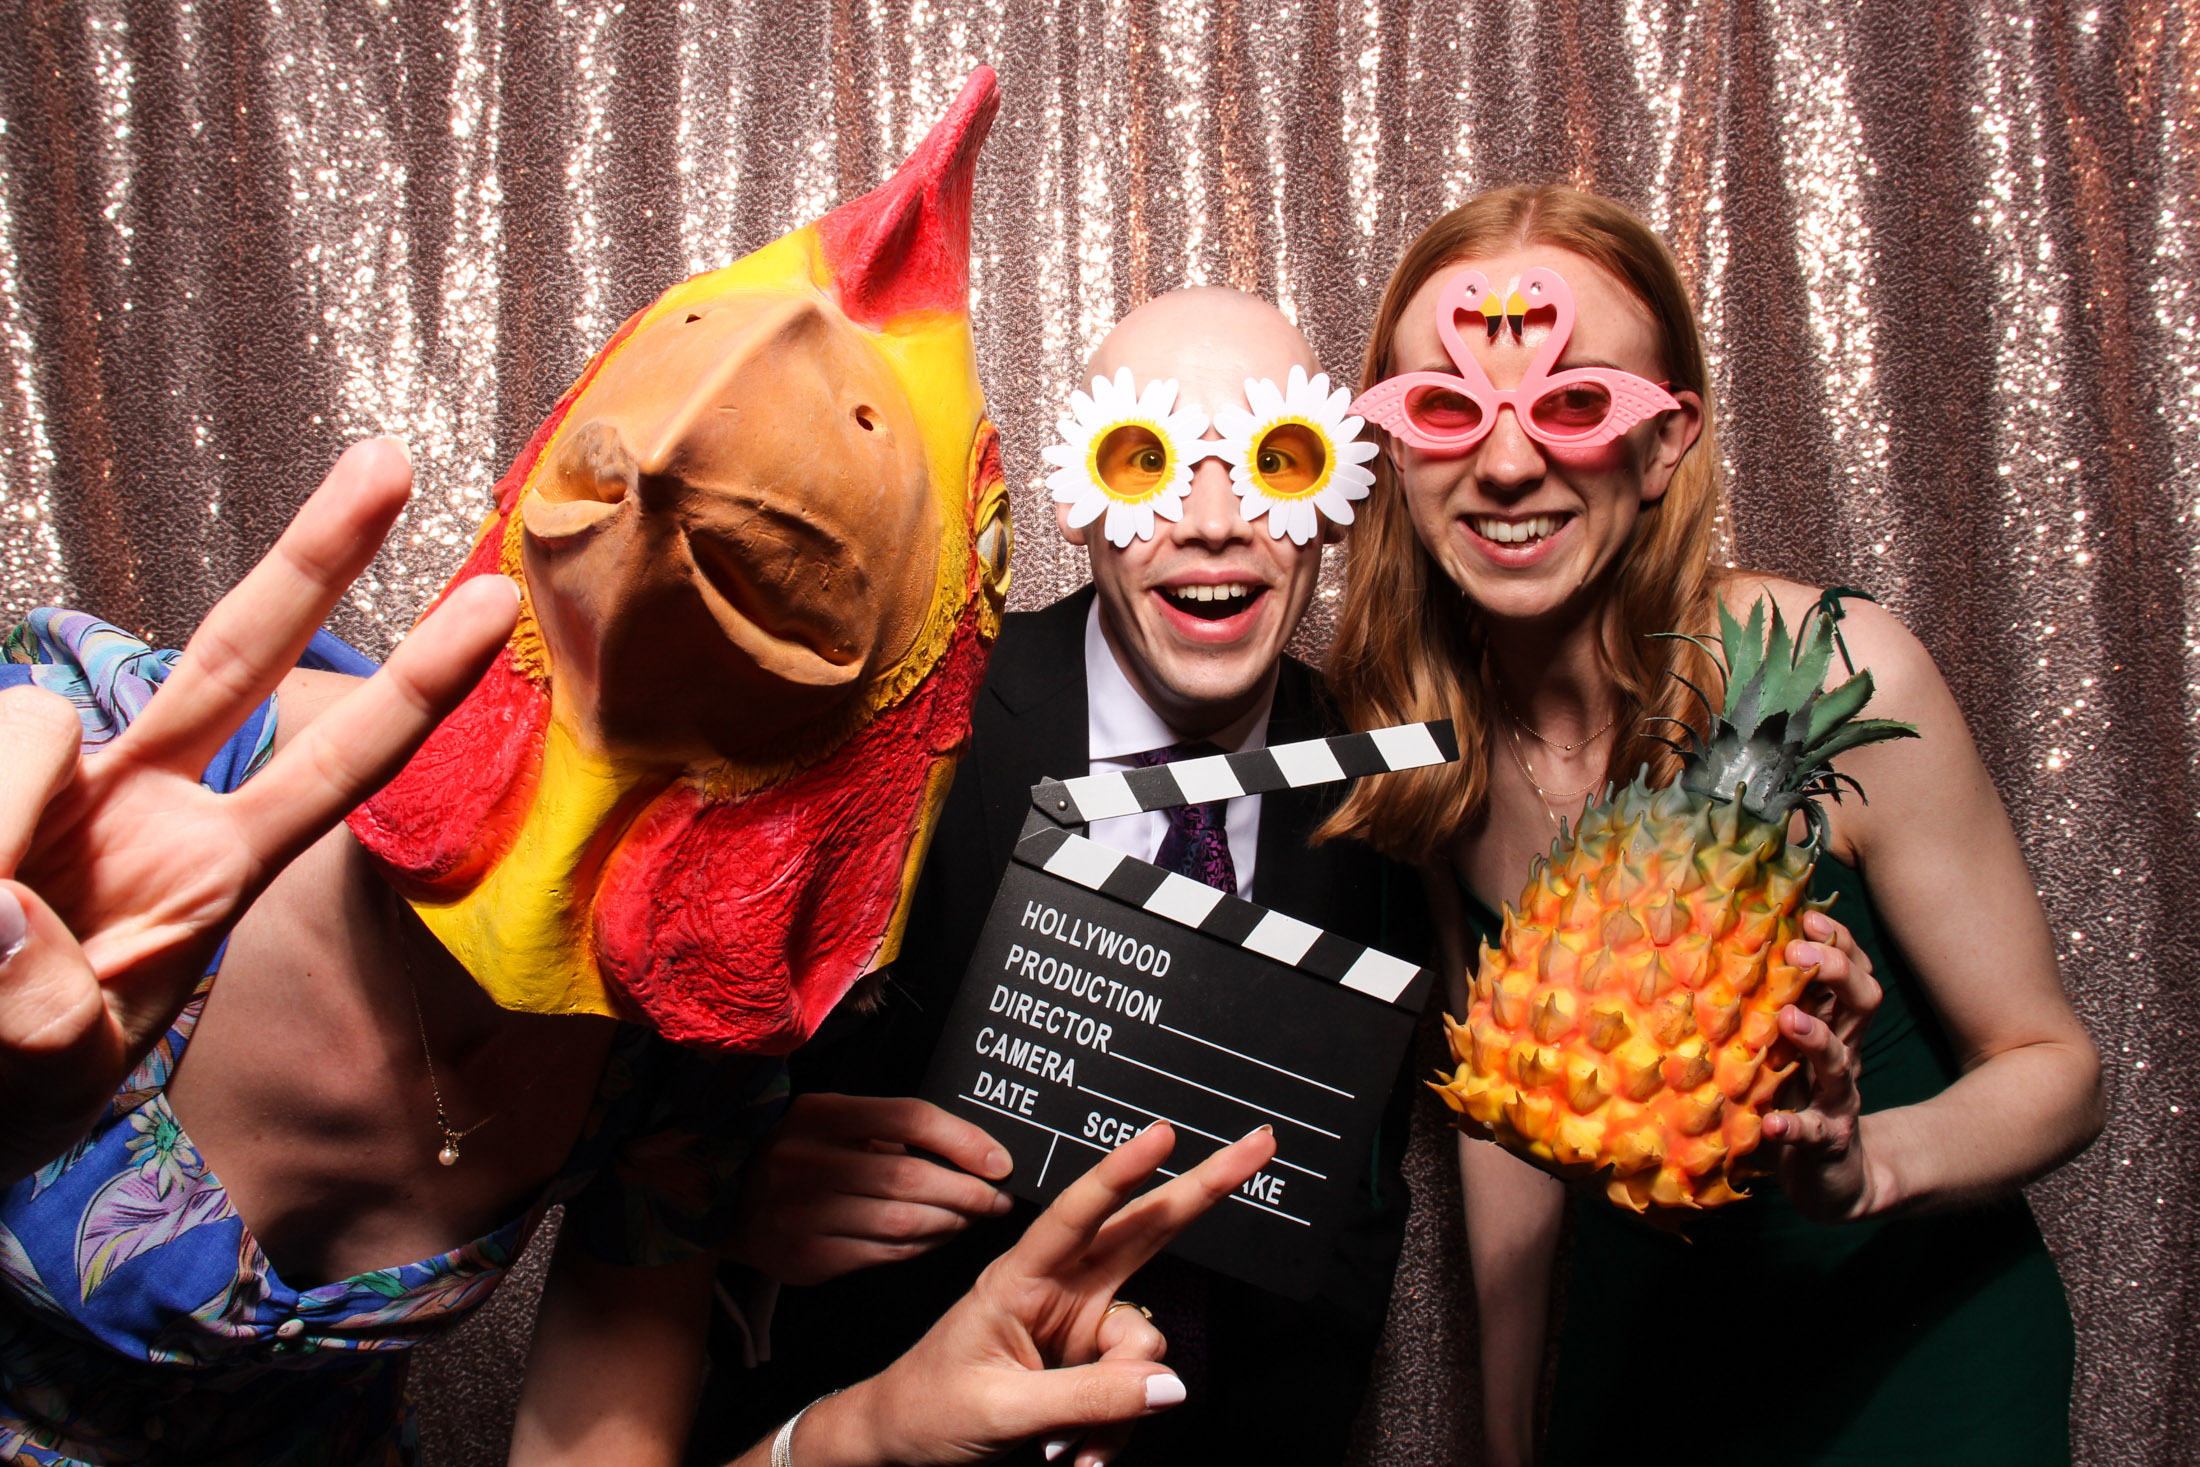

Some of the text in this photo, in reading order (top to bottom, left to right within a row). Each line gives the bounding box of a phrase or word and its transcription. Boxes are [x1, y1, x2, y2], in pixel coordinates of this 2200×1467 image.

[1020, 900, 1171, 978] HOLLYWOOD
[988, 984, 1113, 1054] DIRECTOR
[1004, 943, 1163, 1025] PRODUCTION
[975, 1026, 1075, 1088] CAMERA
[973, 1070, 1286, 1205] DATE SCE KE
